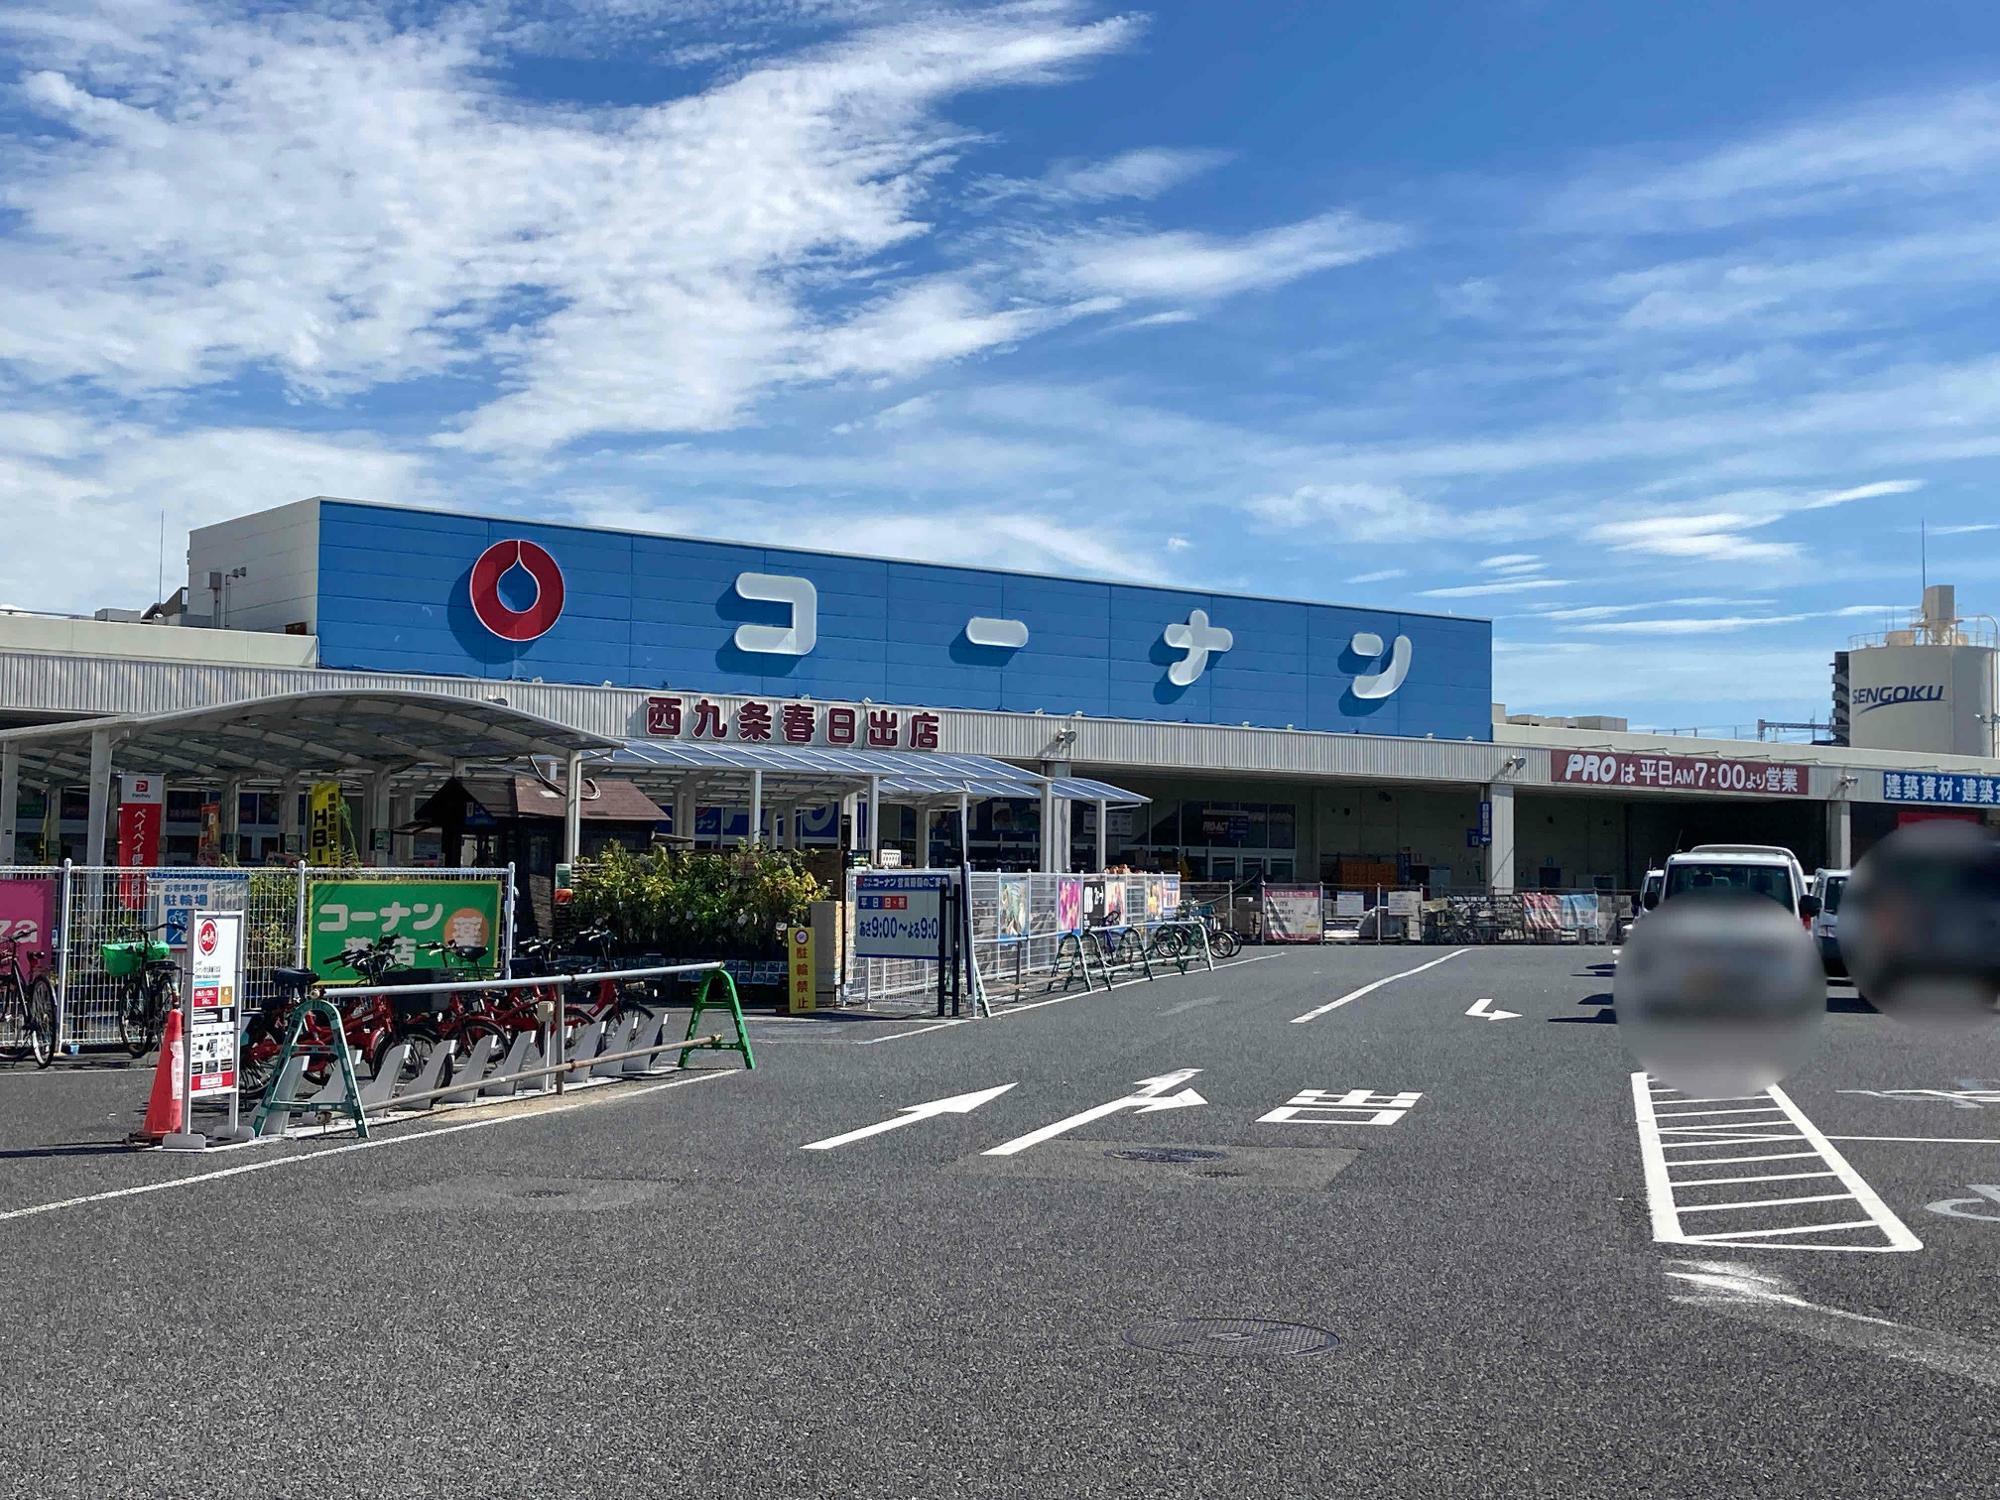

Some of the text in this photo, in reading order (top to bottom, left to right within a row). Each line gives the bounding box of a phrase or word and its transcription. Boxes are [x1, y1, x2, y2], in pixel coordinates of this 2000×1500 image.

[732, 570, 1413, 701] コーナン
[1852, 685, 1944, 705] SENGOKU
[647, 696, 940, 750] 西九条春日出店
[163, 894, 208, 906] 駐輪場
[318, 901, 444, 932] コーナン
[795, 946, 809, 1009] 駐輪禁止
[1254, 1089, 1424, 1126] 出
